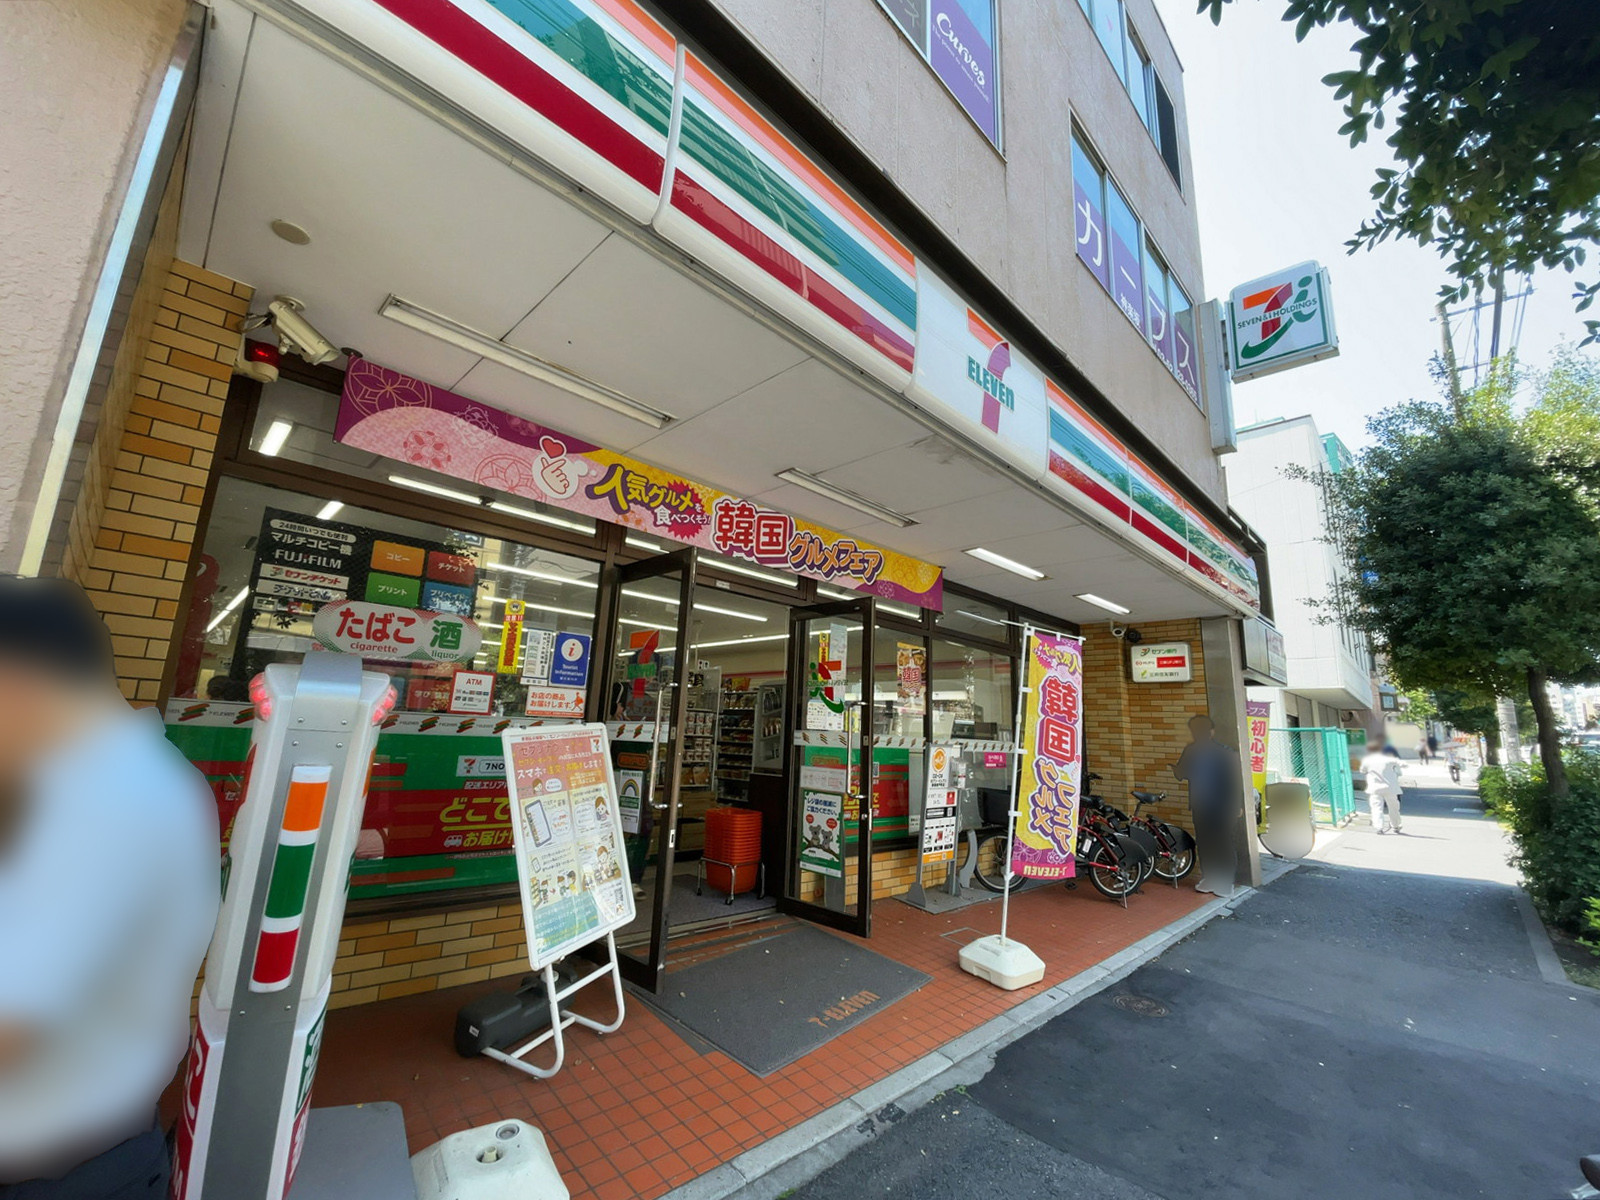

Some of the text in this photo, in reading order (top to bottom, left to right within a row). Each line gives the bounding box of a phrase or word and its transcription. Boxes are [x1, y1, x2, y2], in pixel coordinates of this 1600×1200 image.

[936, 12, 986, 87] Curves
[1077, 199, 1195, 386] カーブス
[1273, 297, 1318, 318] HOLDINGS
[271, 531, 353, 555] マルチコピー機
[274, 549, 342, 570] FUJIFILM
[385, 552, 411, 563] コピー
[438, 561, 466, 574] チケット
[284, 569, 342, 585] セブンチケット
[377, 583, 408, 596] プリント
[335, 607, 417, 644] たばこ
[429, 619, 464, 651] 酒
[350, 641, 398, 654] cigarette
[431, 650, 460, 660] liquor
[466, 678, 483, 686] ATM
[1250, 719, 1267, 773] 初心者
